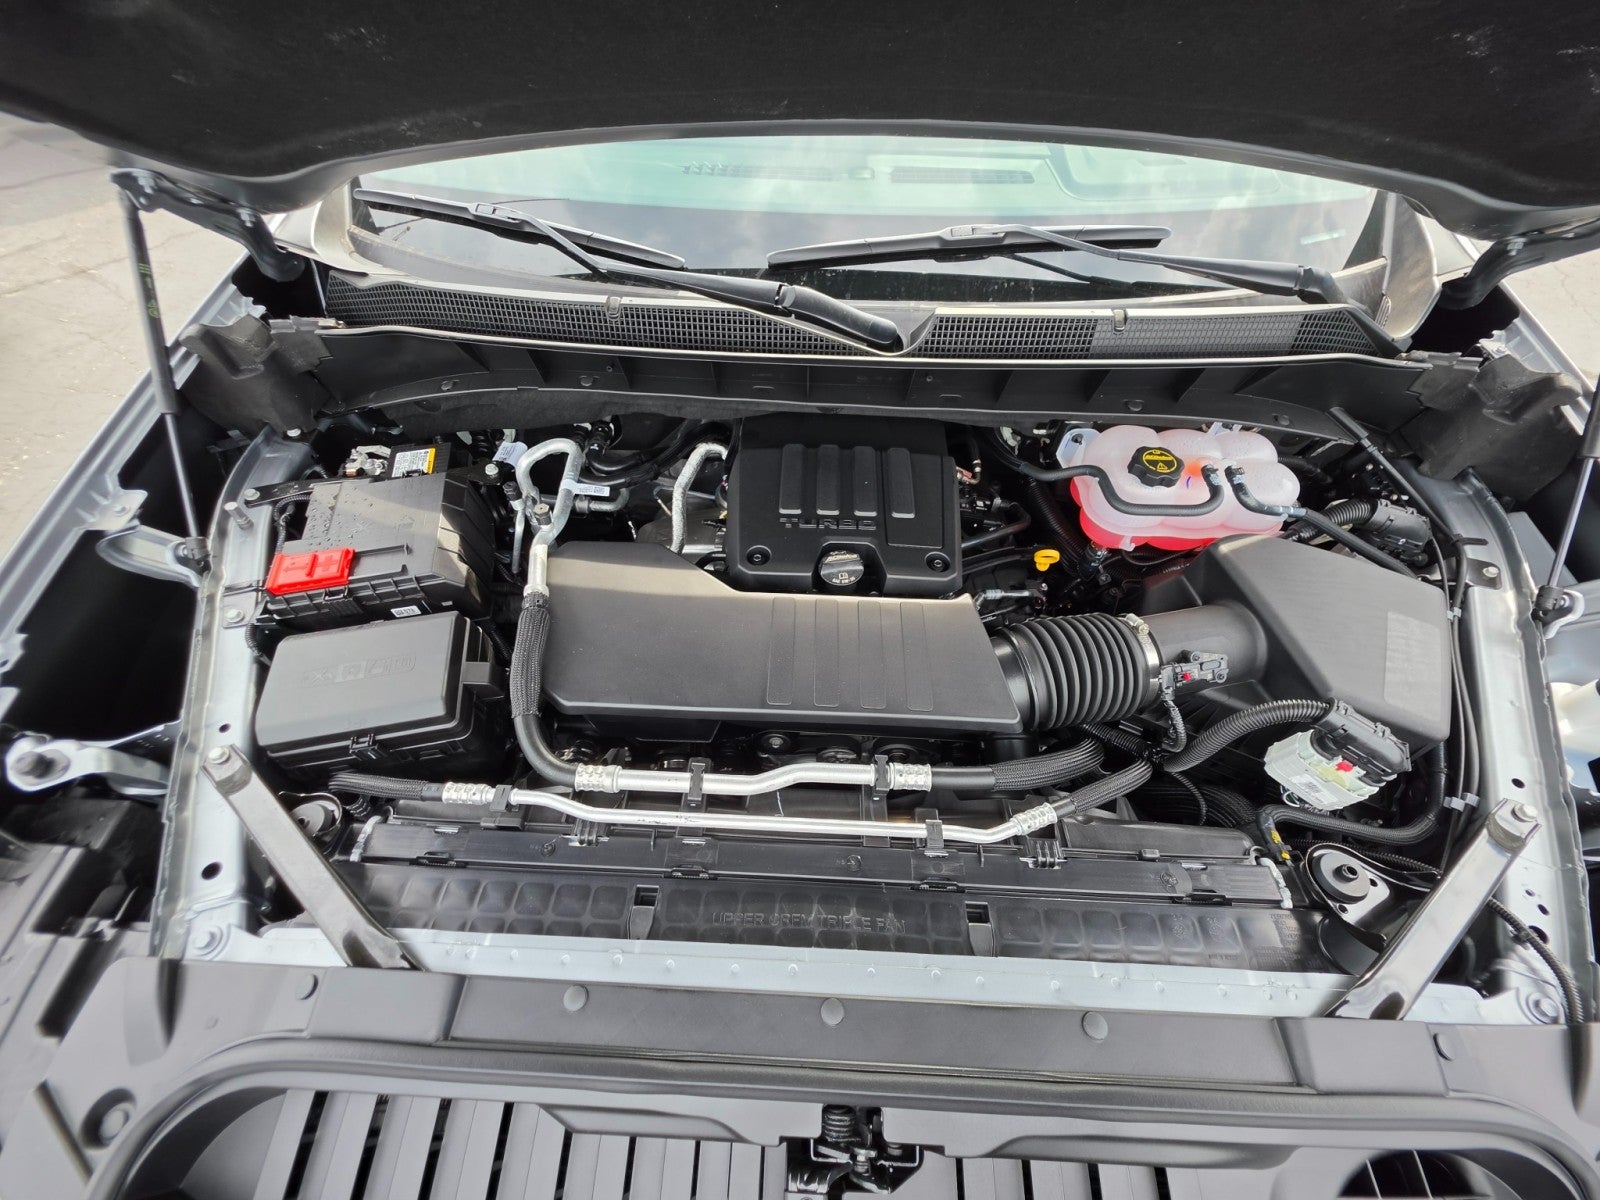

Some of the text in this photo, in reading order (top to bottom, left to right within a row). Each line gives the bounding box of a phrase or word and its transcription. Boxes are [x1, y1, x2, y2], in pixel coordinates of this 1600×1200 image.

[779, 518, 876, 530] TURBO
[712, 912, 765, 927] UPPER
[817, 914, 871, 931] TRIPLE
[876, 917, 905, 934] FAN
